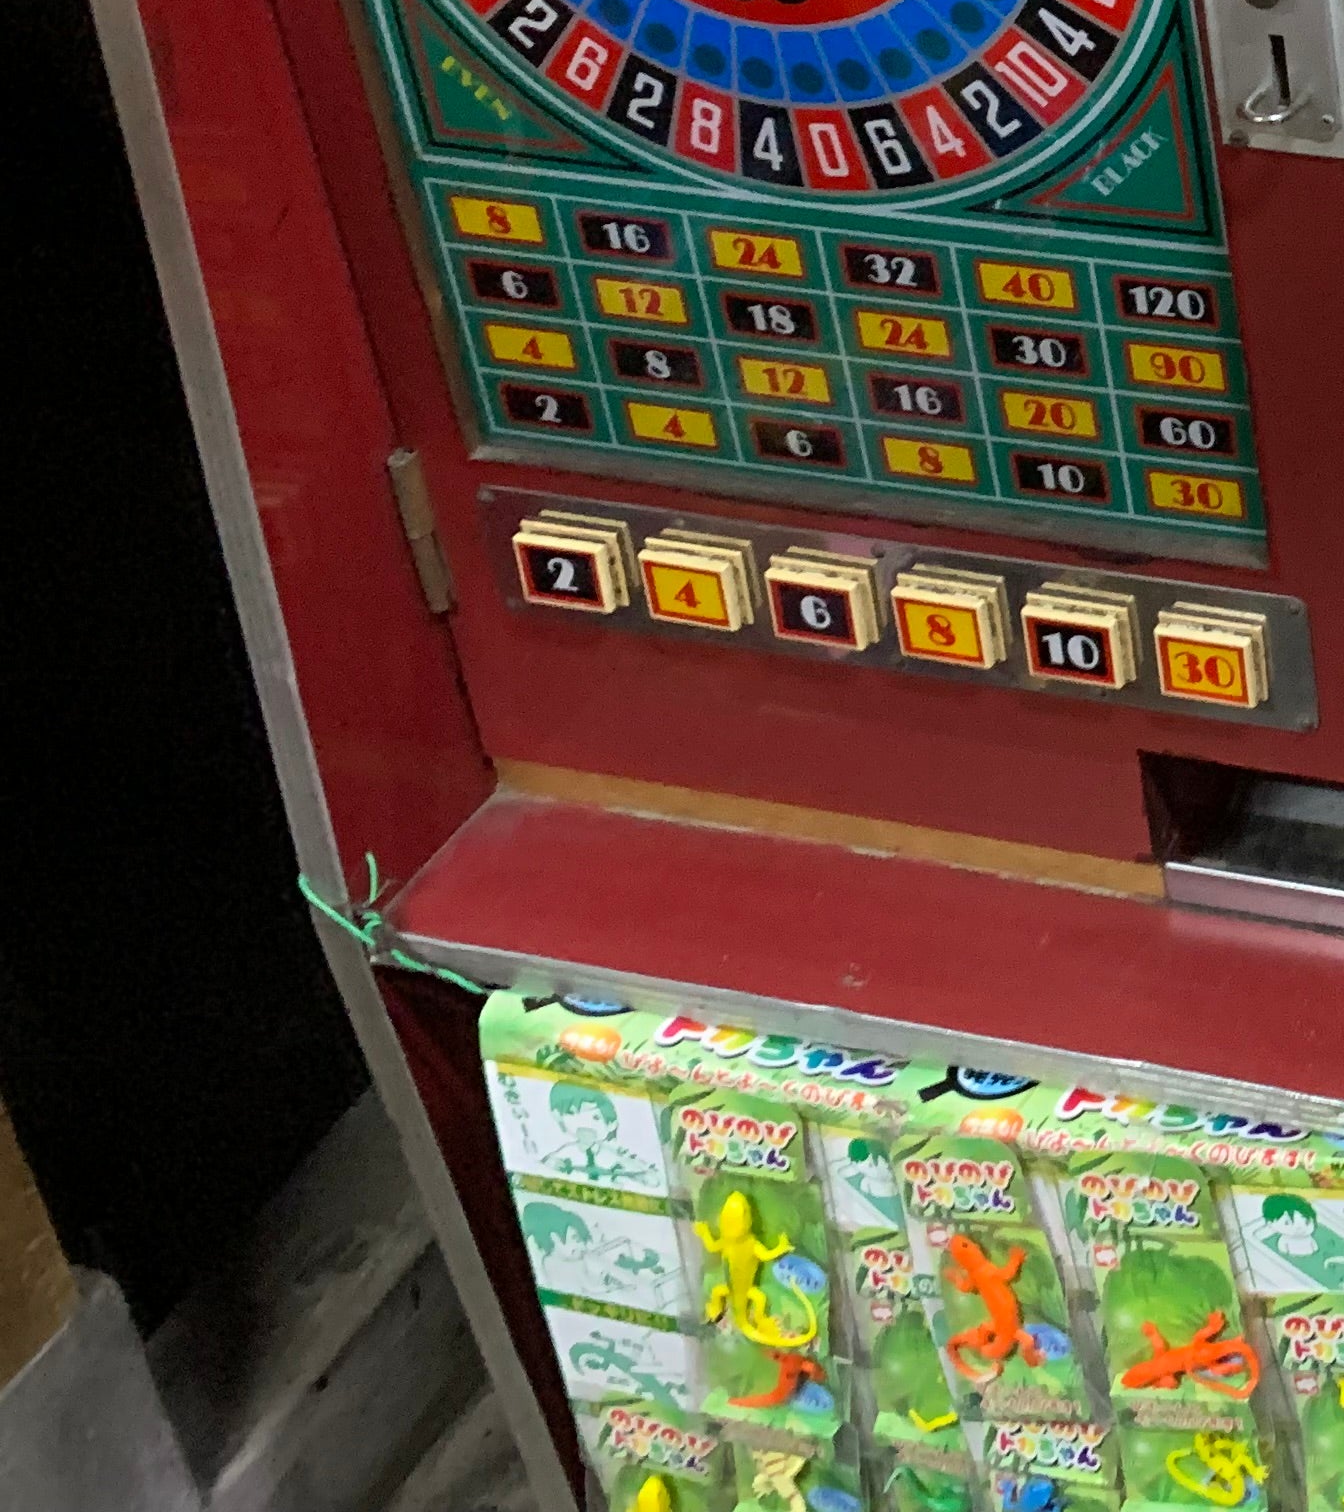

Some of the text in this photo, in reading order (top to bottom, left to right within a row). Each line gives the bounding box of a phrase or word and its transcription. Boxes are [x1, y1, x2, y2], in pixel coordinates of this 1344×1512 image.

[1038, 8, 1097, 56] 4
[566, 35, 607, 91] 6
[997, 42, 1068, 108] 10
[627, 77, 663, 129] 2
[690, 99, 720, 154] 8
[927, 105, 966, 157] 4
[961, 79, 1023, 137] 2
[753, 117, 784, 171] 4
[809, 123, 849, 177] 0
[873, 121, 911, 174] 6
[1090, 125, 1170, 198] BLACK
[486, 205, 1206, 320] 8 16 24 32 40 120
[502, 270, 1206, 385] 6 12 18 24 30 90
[523, 334, 1217, 450] 4 8 12 16 20 60
[535, 395, 1223, 511] 2 4 6 8 10 30
[546, 558, 1236, 689] 2 4 6 8 10 30
